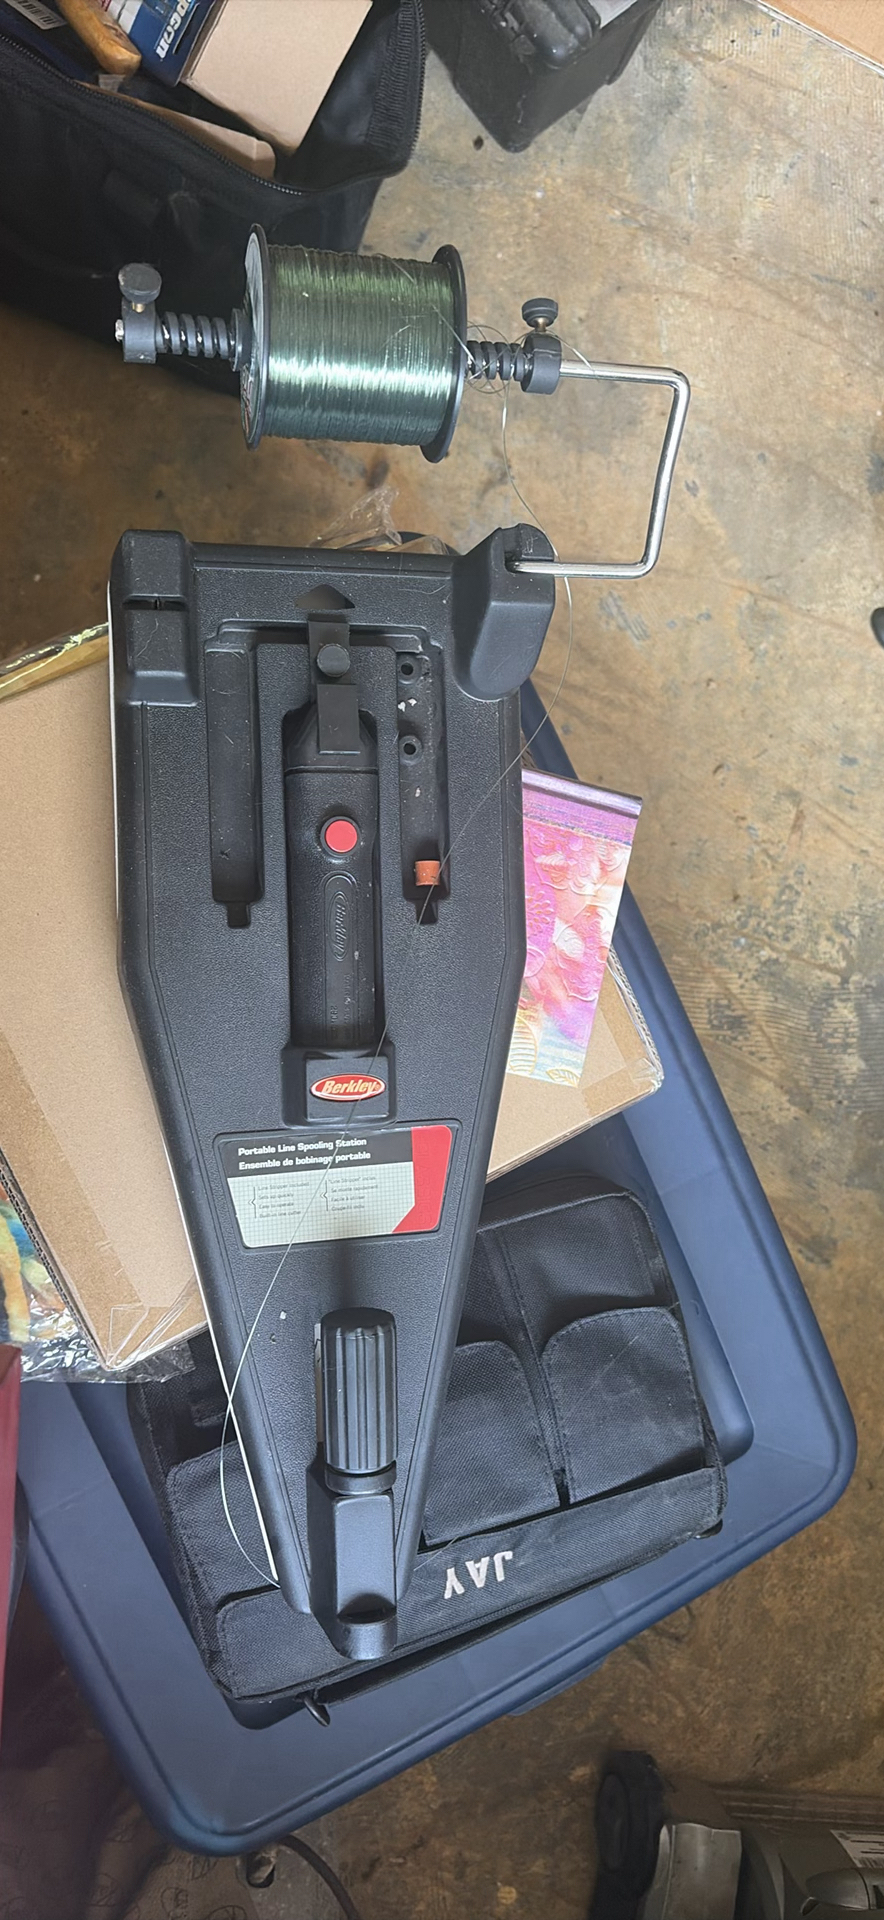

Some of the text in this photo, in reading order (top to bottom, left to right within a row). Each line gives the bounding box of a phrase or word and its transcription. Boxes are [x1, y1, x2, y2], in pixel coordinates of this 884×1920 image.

[321, 1080, 379, 1094] Berkley
[238, 1138, 367, 1156] Portable Line Spooling Station
[239, 1151, 371, 1170] Ensemble de bobinage portable
[444, 1550, 513, 1600] JAY
